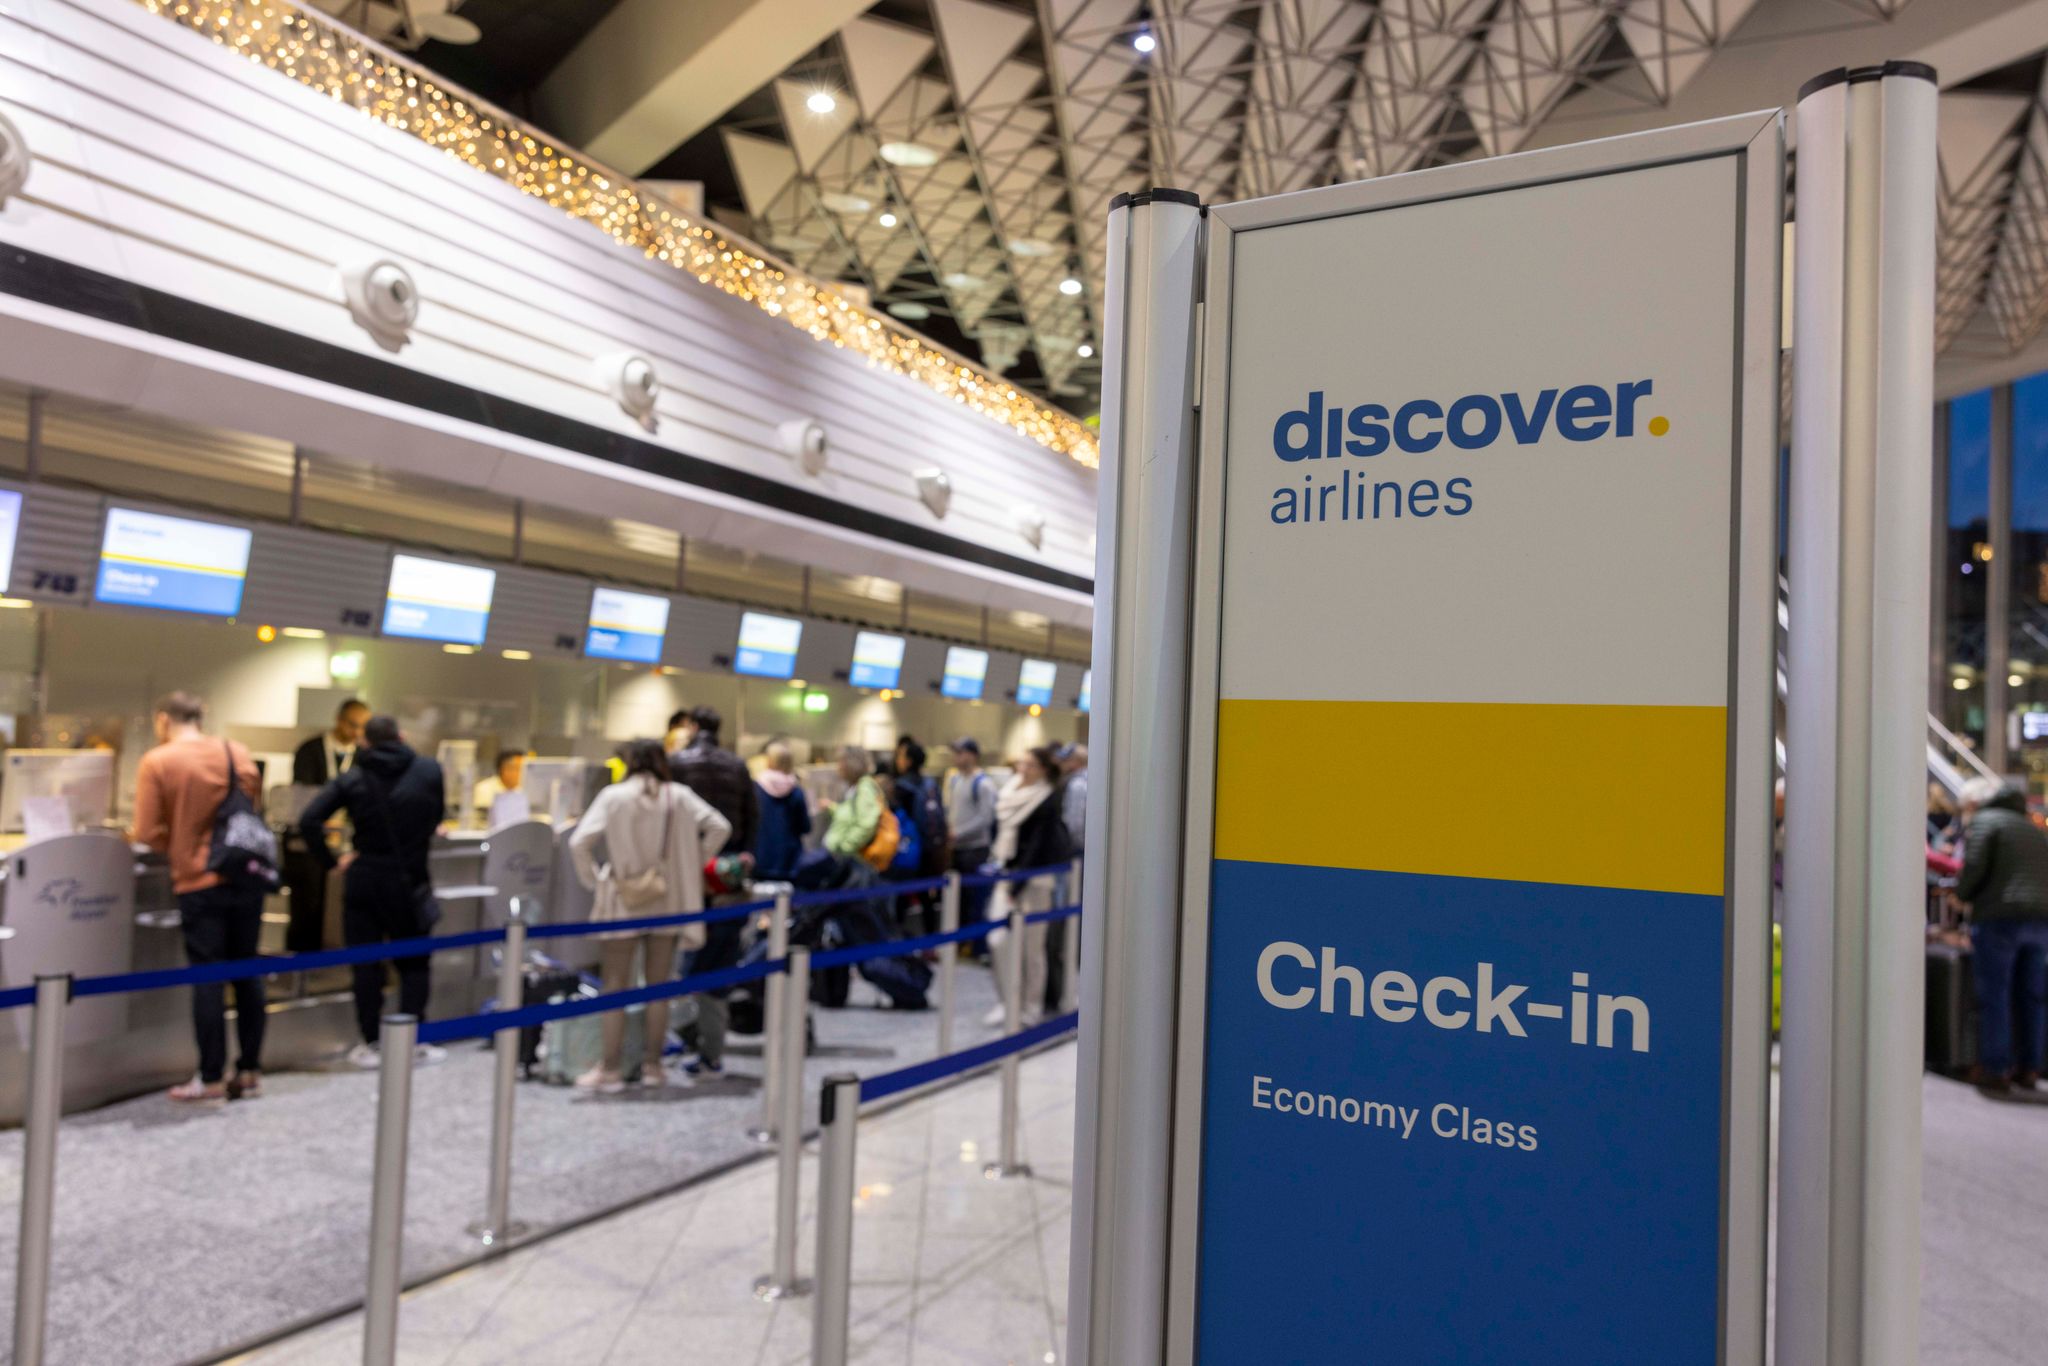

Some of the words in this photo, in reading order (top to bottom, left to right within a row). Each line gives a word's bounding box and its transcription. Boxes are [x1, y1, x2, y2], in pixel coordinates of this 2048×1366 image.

[1270, 469, 1473, 525] airlines
[1256, 941, 1650, 1053] Check-in
[1252, 1075, 1420, 1140] Economy
[1431, 1103, 1538, 1151] Class
